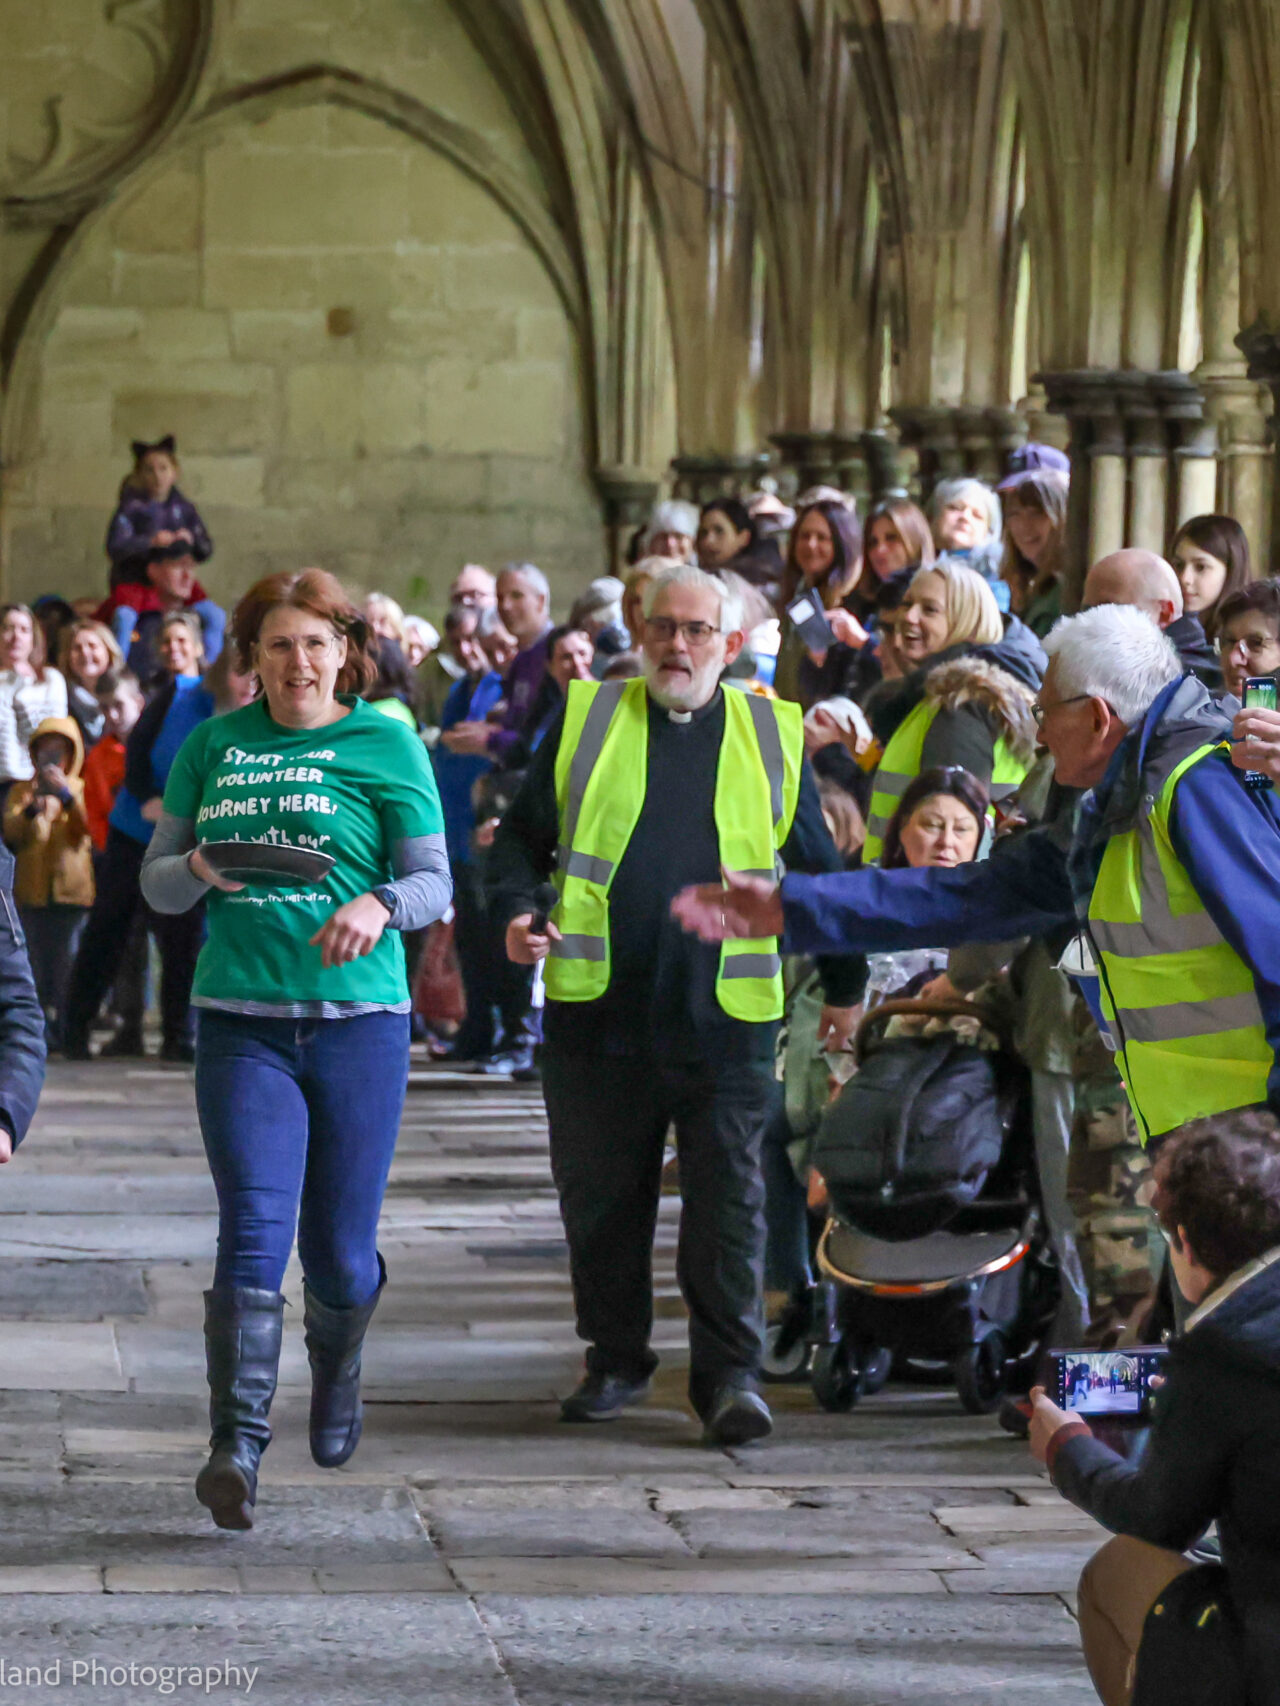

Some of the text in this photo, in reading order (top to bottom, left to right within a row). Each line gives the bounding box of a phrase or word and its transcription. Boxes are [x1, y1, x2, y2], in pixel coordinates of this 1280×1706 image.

[223, 746, 336, 767] START UR
[217, 767, 324, 788] VOLUNTEER
[198, 793, 338, 823] JOURNEY HERE!
